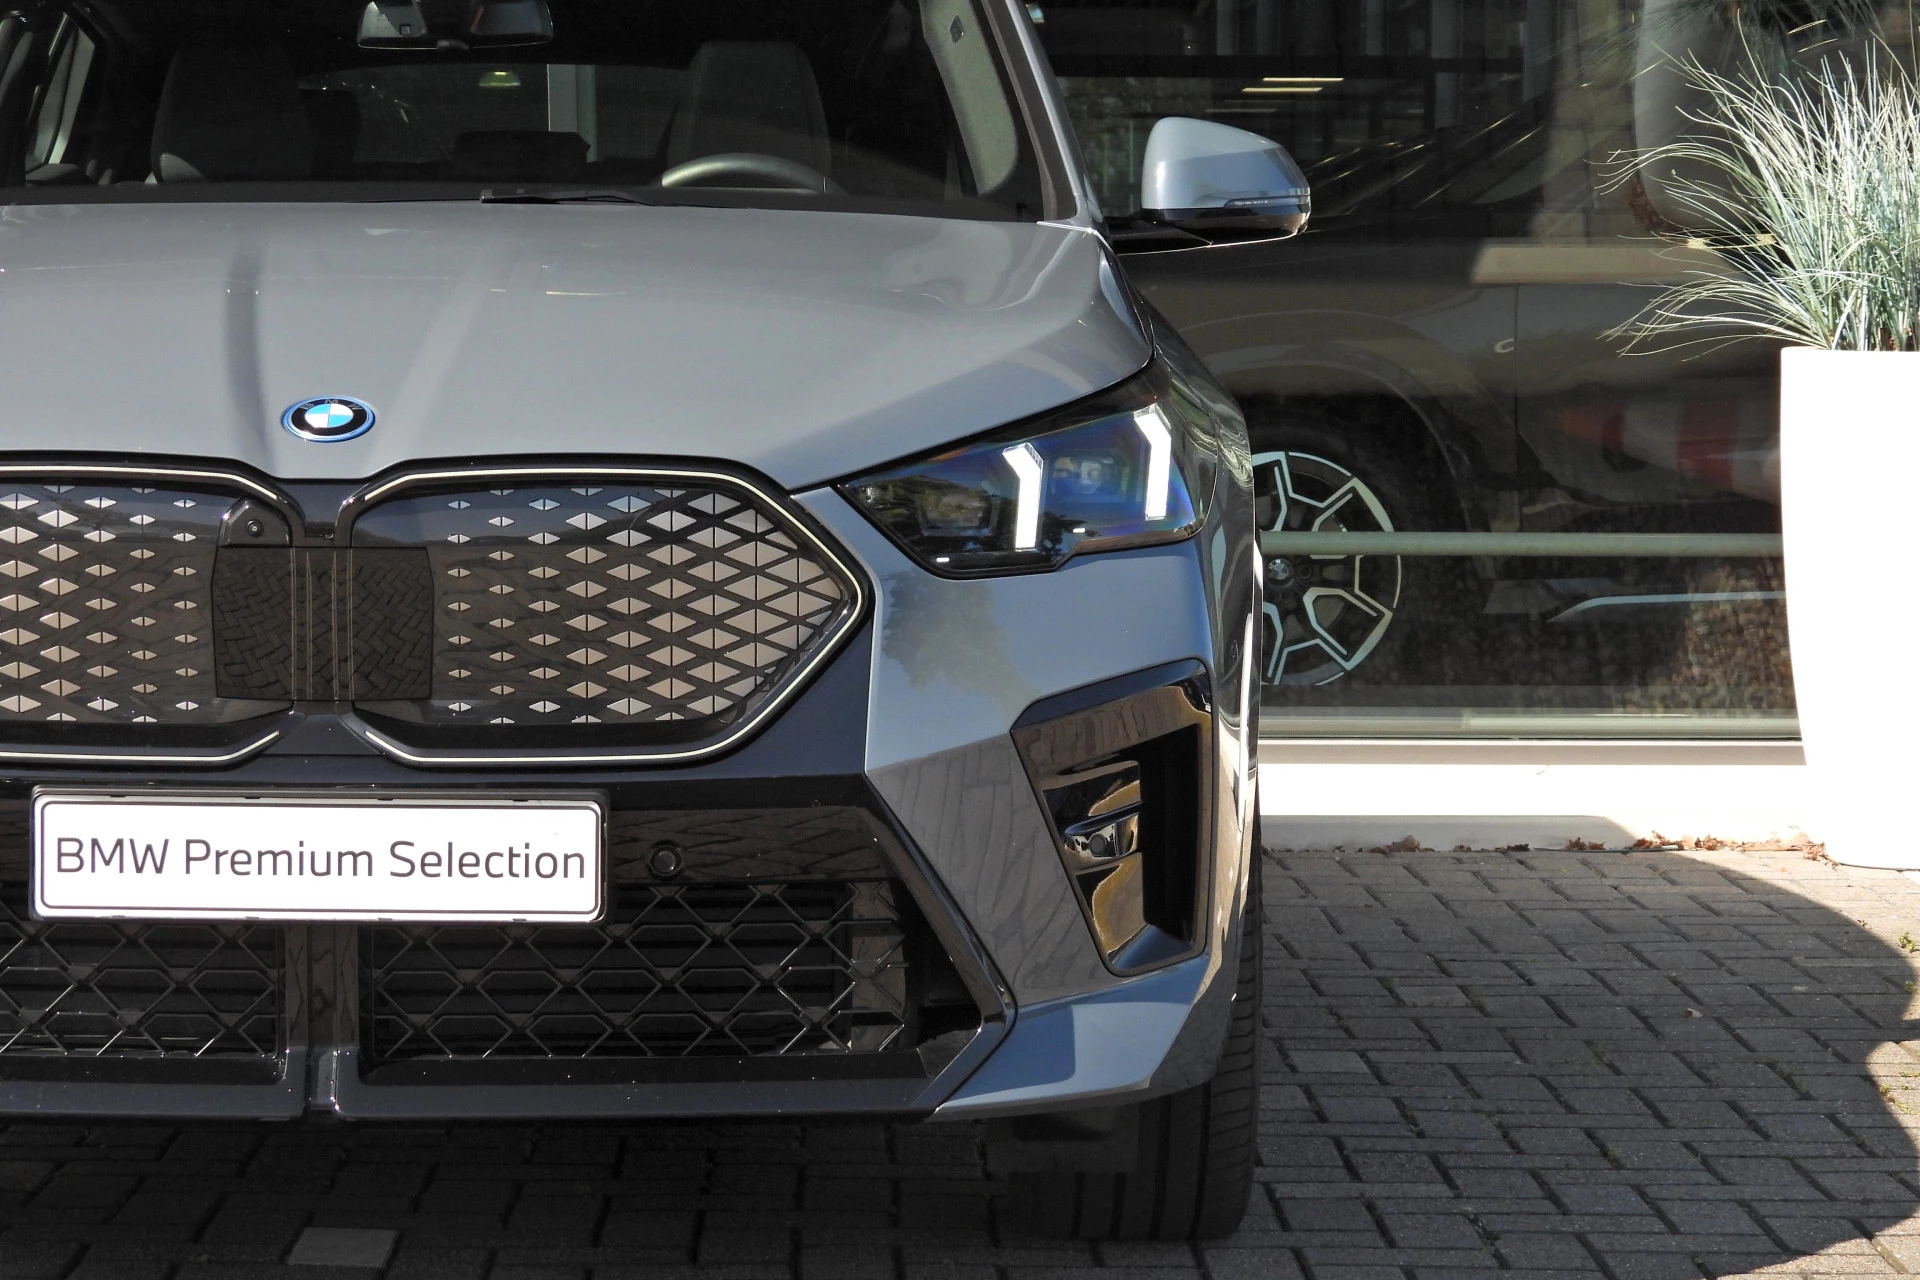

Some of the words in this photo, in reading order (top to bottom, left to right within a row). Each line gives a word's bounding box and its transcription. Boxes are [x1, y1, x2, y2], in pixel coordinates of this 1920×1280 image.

[299, 399, 363, 410] BMW
[57, 837, 169, 873] BMW
[185, 839, 373, 876] Premium
[389, 840, 585, 878] Selection
